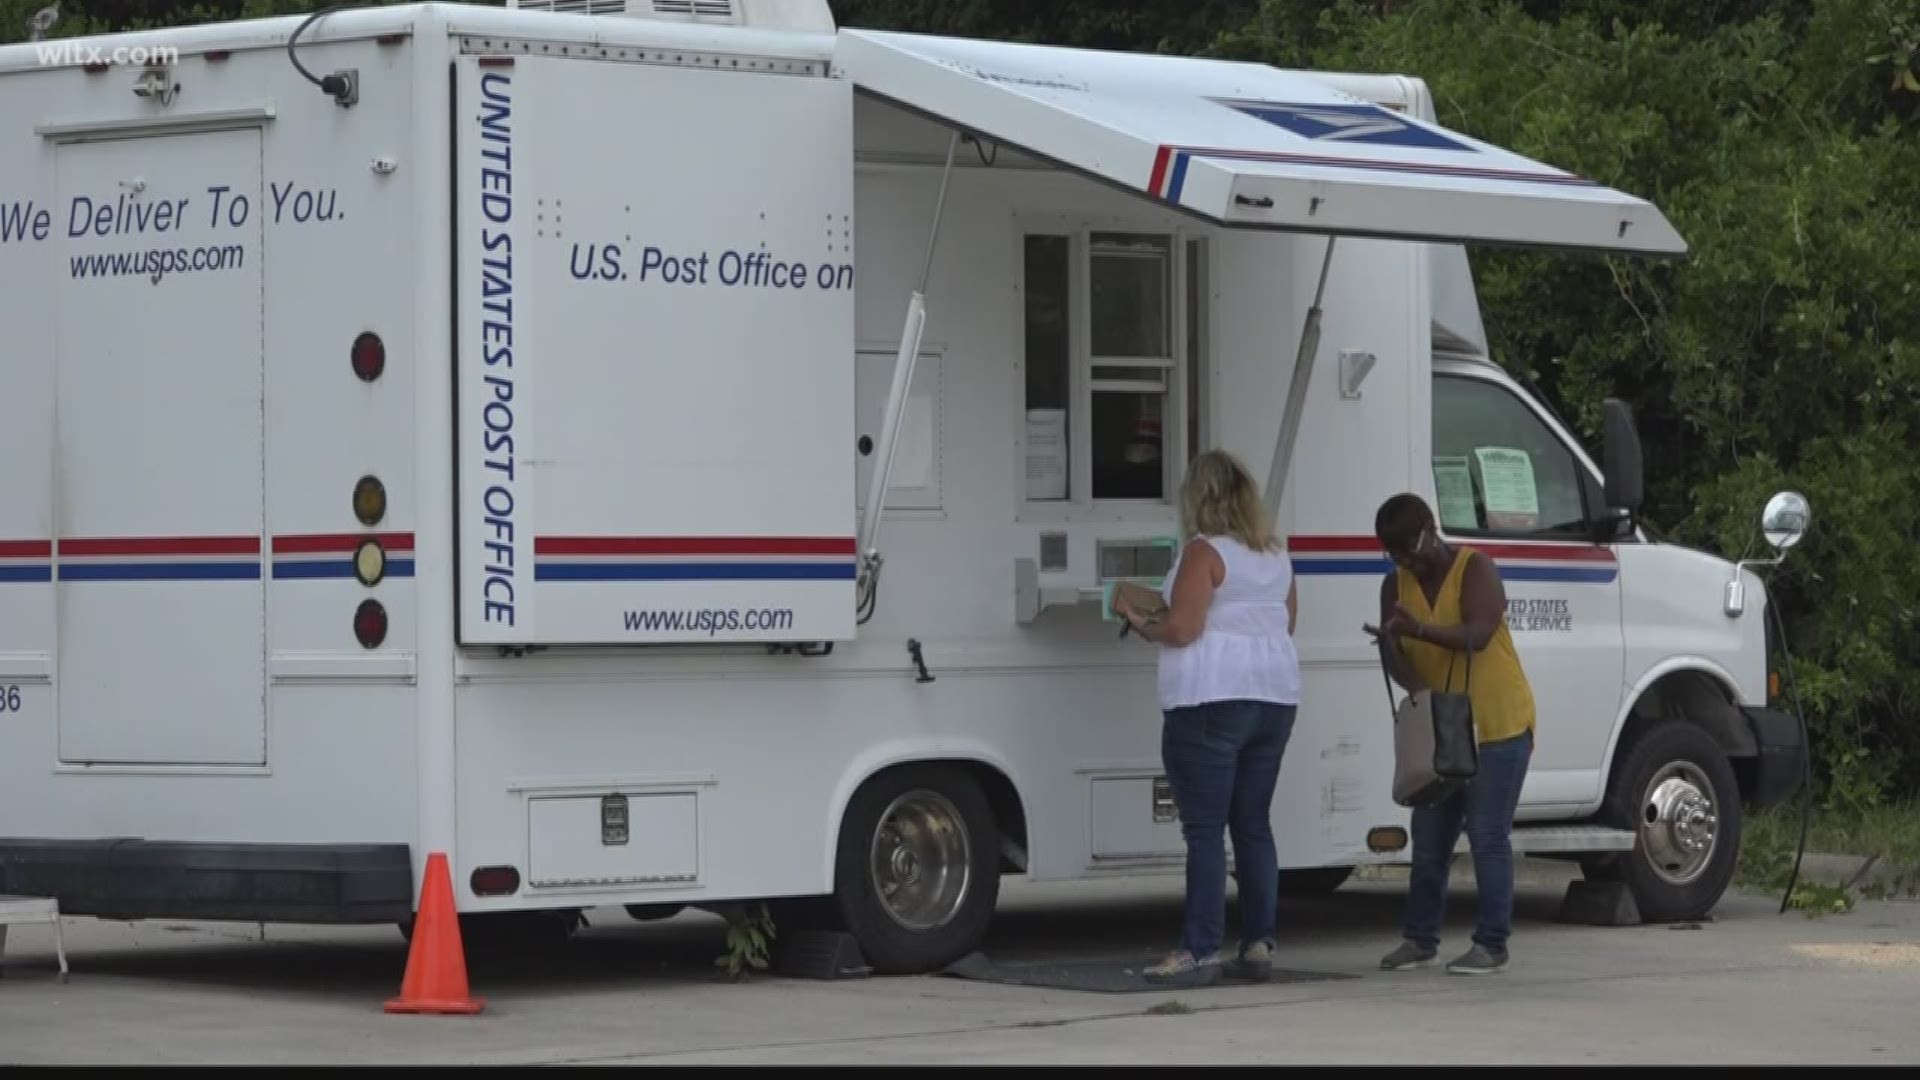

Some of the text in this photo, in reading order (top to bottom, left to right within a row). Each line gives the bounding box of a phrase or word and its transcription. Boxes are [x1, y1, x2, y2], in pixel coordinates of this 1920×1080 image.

[1, 181, 344, 243] We Deliver To You.
[71, 245, 243, 279] www.usps.com
[570, 244, 853, 289] U.S. Post Office on
[481, 72, 514, 627] UNITED STATES POST OFFICE
[624, 609, 793, 636] www.usps.com
[1527, 616, 1572, 631] SERVICE
[1530, 600, 1568, 613] STATES
